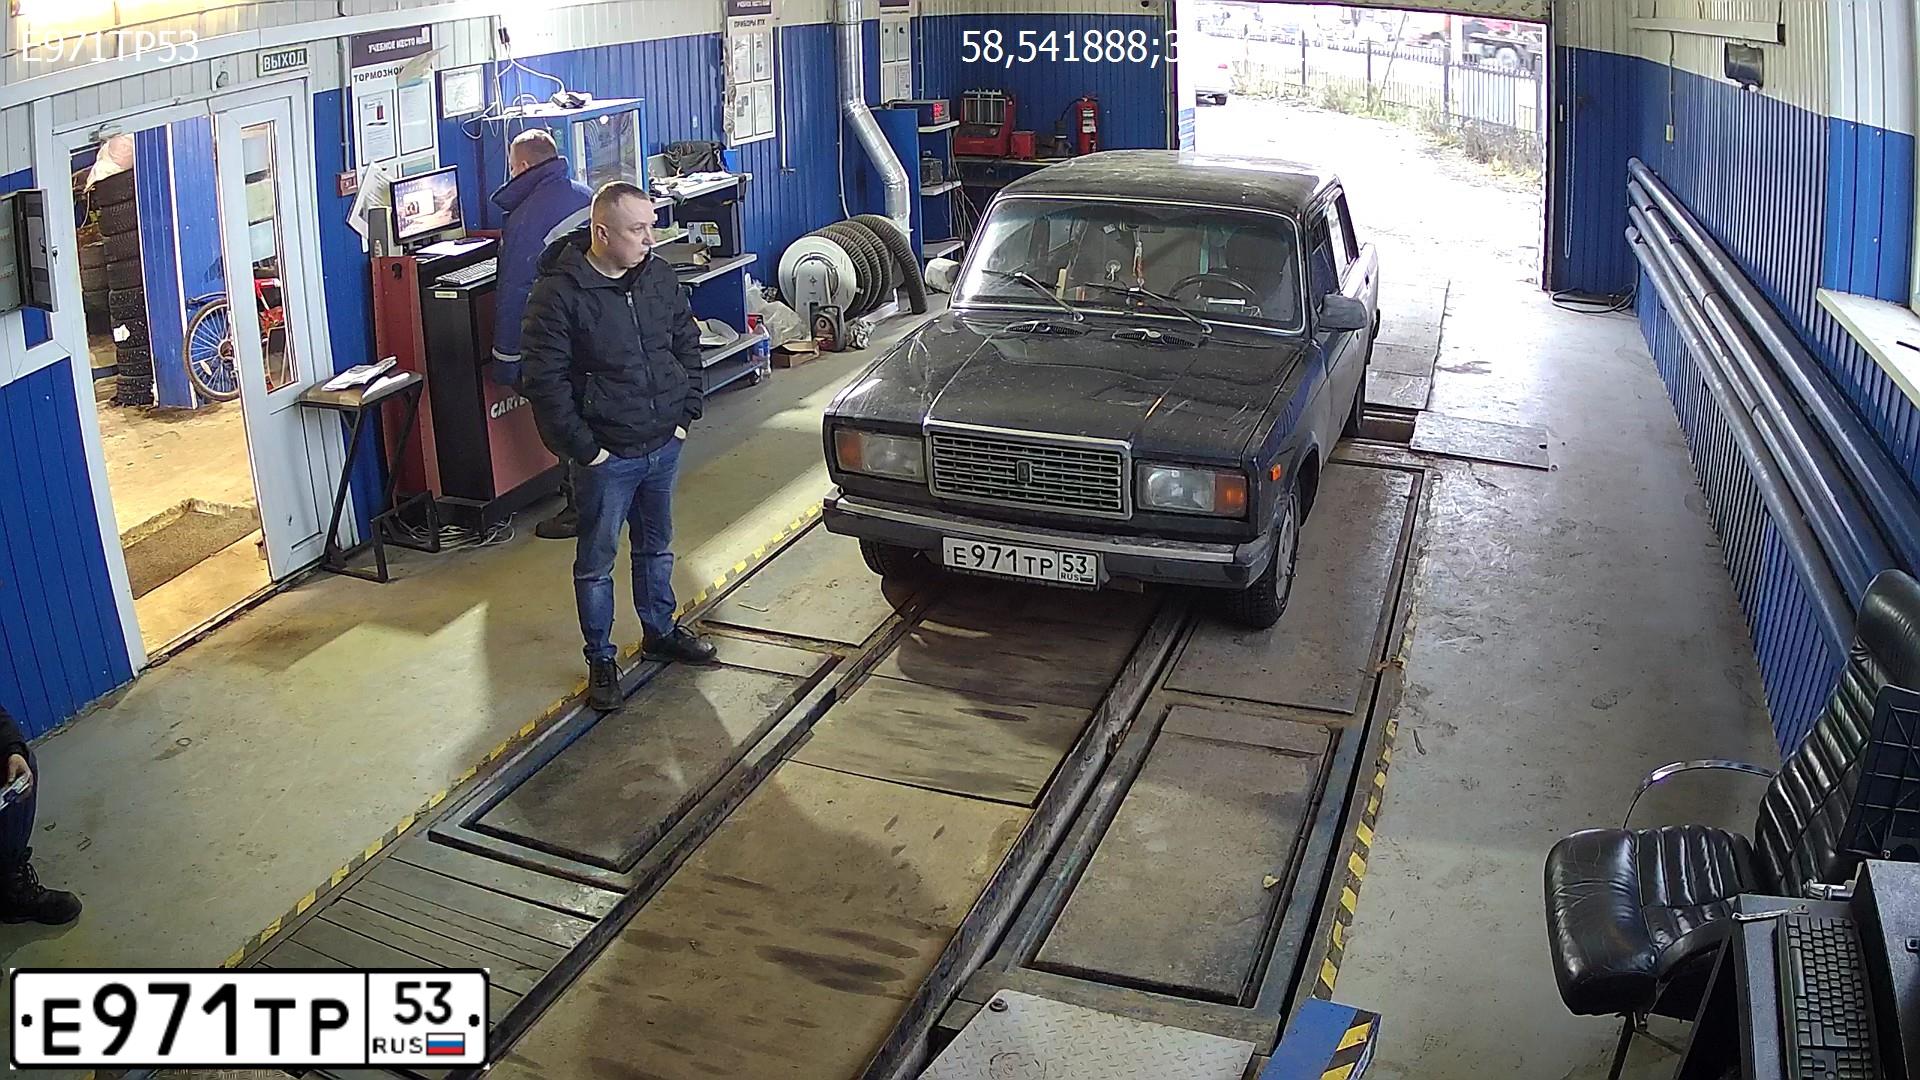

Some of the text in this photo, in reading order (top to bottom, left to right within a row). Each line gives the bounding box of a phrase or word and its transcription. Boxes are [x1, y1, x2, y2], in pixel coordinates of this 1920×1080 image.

[368, 40, 396, 54] УЧЕБНОЕ
[396, 37, 416, 49] МЕСТО
[263, 50, 306, 70] ВЫХОД
[1062, 554, 1088, 575] 53
[1060, 572, 1080, 582] RUS
